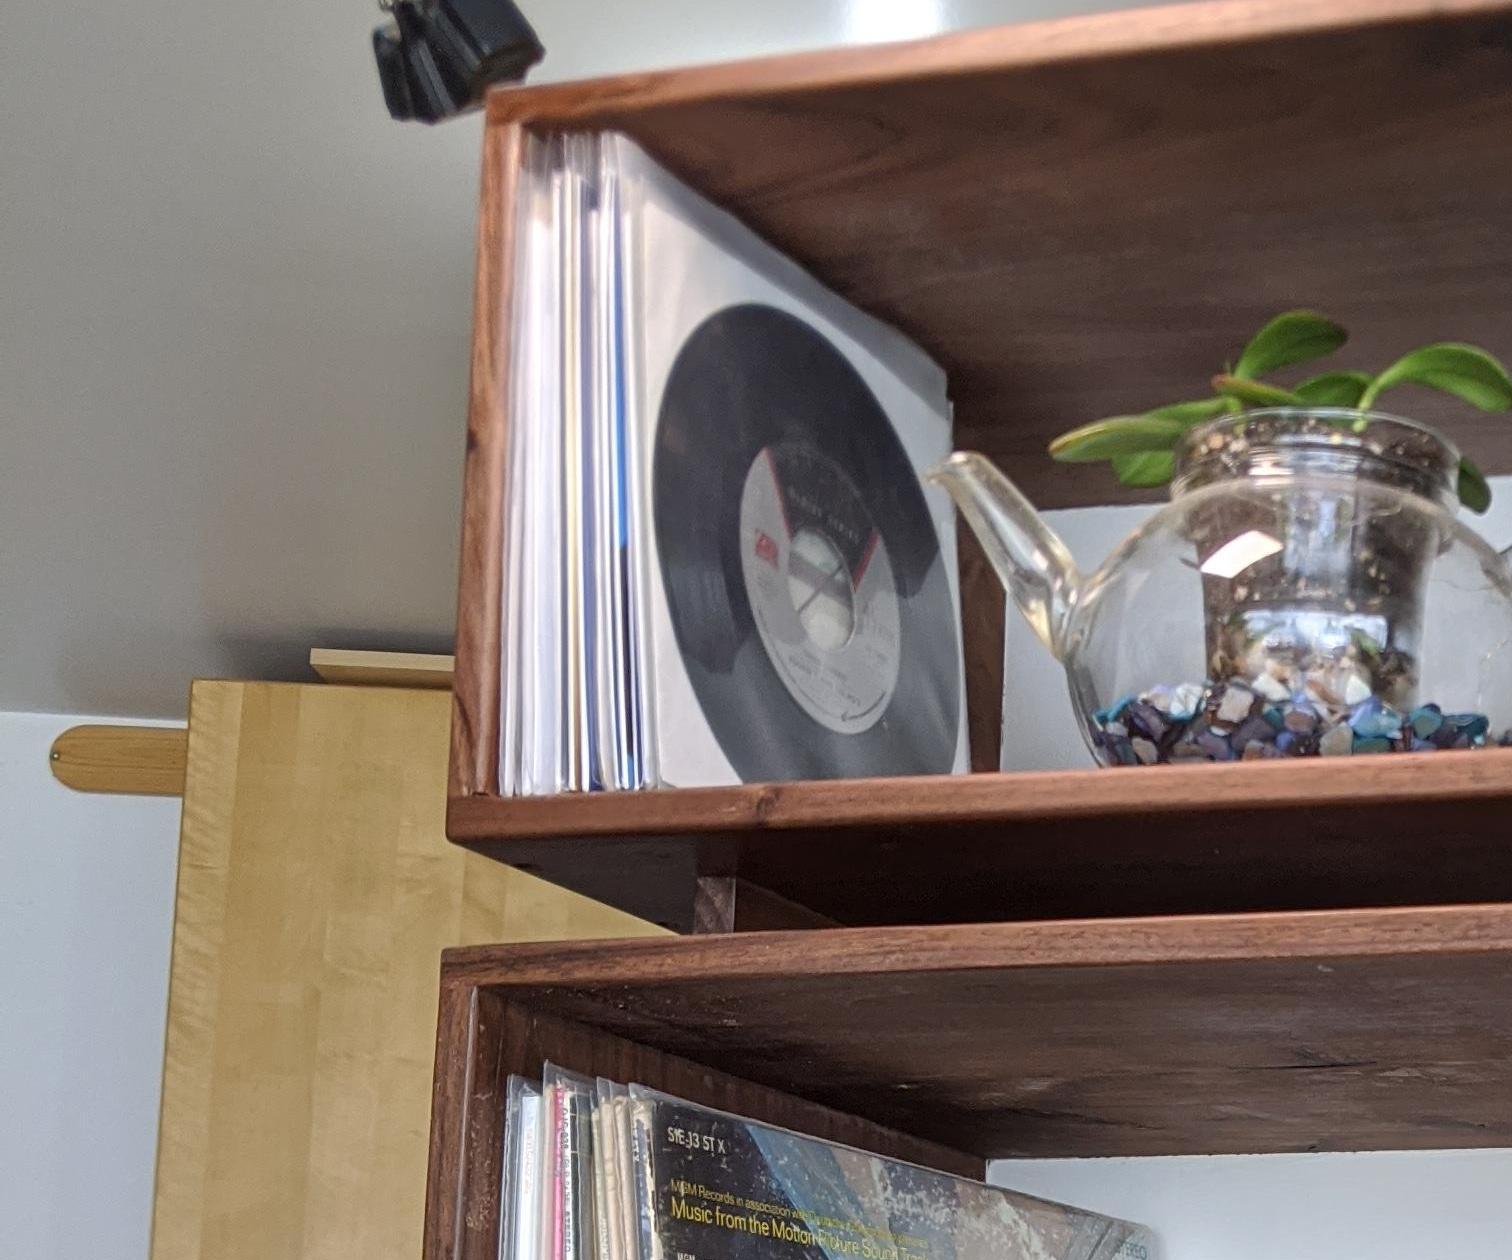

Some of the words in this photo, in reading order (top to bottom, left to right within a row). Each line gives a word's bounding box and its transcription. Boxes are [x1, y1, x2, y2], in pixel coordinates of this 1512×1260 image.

[699, 1184, 735, 1206] Records
[736, 1197, 744, 1207] in
[745, 1199, 791, 1217] association
[671, 1196, 712, 1224] Music
[716, 1205, 746, 1231] from
[748, 1215, 769, 1236] the
[772, 1218, 816, 1246] Motion
[818, 1229, 860, 1255] Picture
